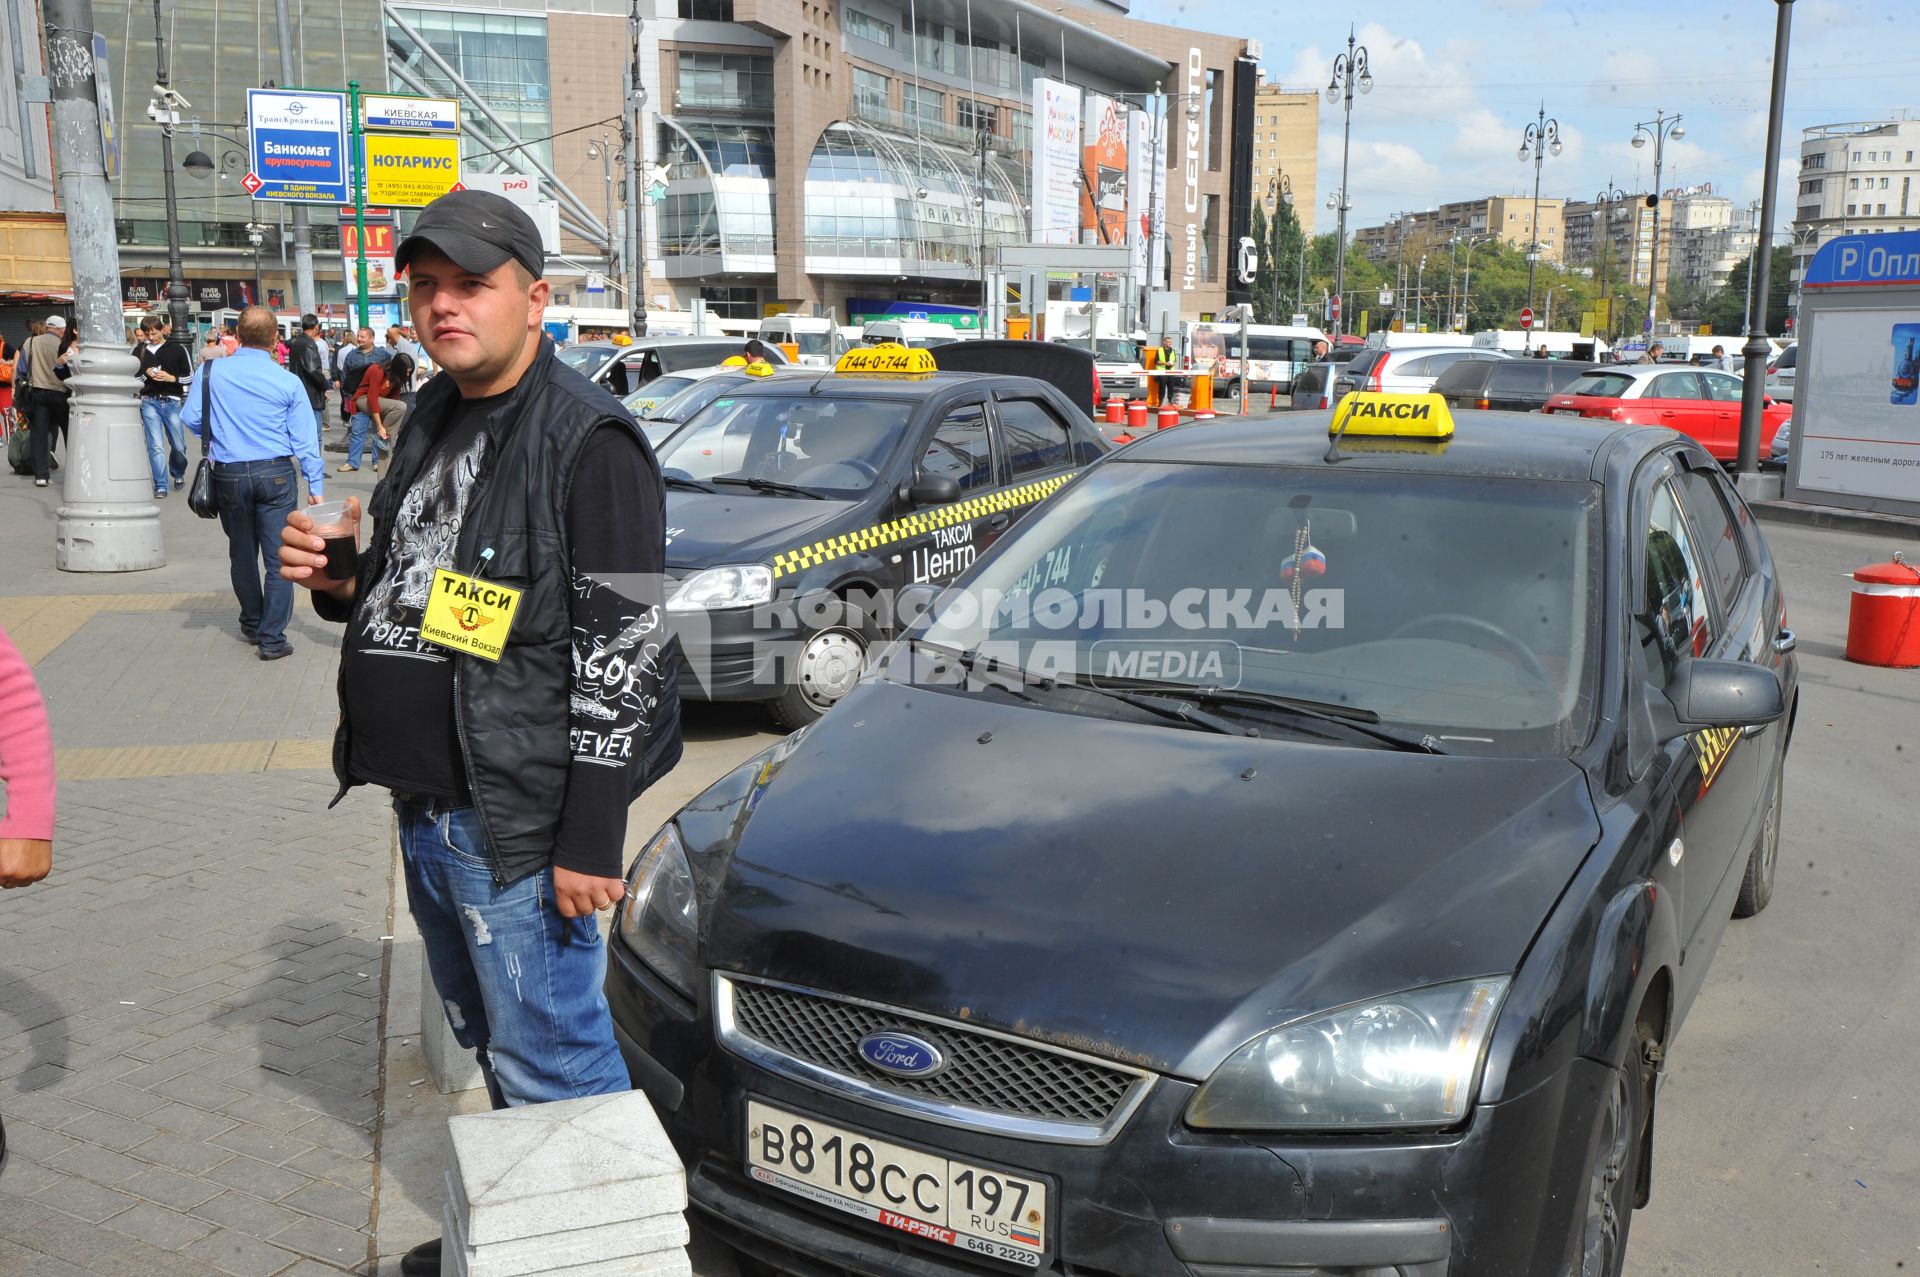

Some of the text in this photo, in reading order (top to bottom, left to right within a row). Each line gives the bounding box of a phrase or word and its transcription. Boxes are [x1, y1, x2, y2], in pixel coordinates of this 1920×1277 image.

[258, 114, 336, 127] ТрансКредитБанк
[384, 108, 438, 119] КИЕВСКАЯ
[390, 118, 433, 127] KIYEVSKAYA
[264, 140, 331, 157] Банкомат
[265, 157, 331, 168] круглосуточно
[373, 154, 452, 169] НОТАРИУС
[266, 190, 303, 198] КИЕВСКОГО
[290, 184, 317, 192] ЗДАНИИ
[844, 355, 910, 369] 744-0-744
[1349, 401, 1431, 420] ТАКСИ
[1821, 450, 1834, 461] 175
[1836, 453, 1848, 462] лет
[1850, 454, 1890, 466] железным
[932, 523, 973, 549] ТАКСИ
[912, 544, 976, 584] Центр
[442, 576, 512, 611] ТАКСИ
[423, 623, 501, 655] Киевский Вокзал
[874, 1040, 917, 1068] Ford
[757, 1170, 771, 1182] KIA
[762, 1122, 1030, 1222] В818СС 197
[775, 1177, 815, 1197] Официальный
[833, 1198, 843, 1206] KIA
[844, 1201, 868, 1214] MOTORS
[882, 1211, 952, 1244] ТИ-РЭКС
[971, 1214, 1009, 1237] RUS
[967, 1237, 1036, 1266] 646 2222
